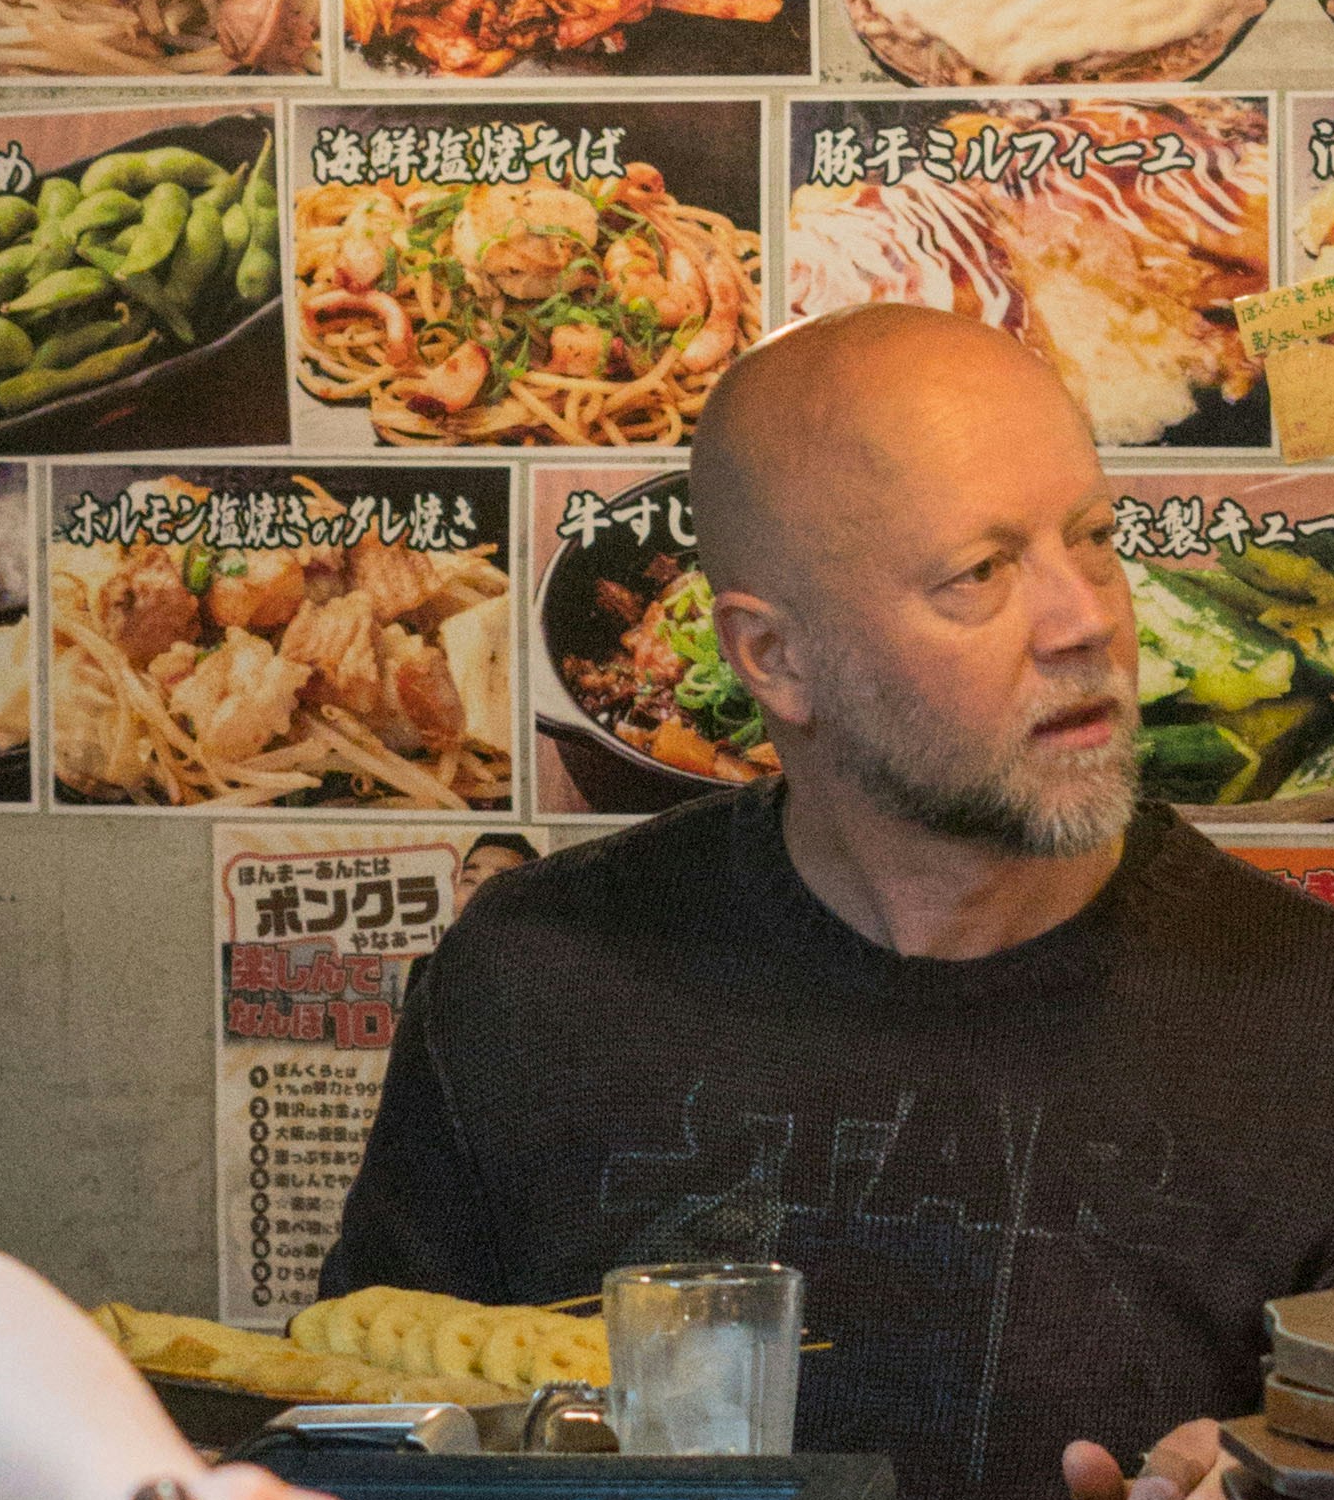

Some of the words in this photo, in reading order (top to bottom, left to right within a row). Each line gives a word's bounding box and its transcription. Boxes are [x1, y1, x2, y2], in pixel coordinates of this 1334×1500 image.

[312, 125, 627, 186] 海鮮塩焼そば
[810, 125, 1195, 187] 豚平ミルフィーユ
[69, 490, 478, 551] ホルモン塩焼きorタレ焼き
[255, 876, 440, 938] ボンクラ
[231, 944, 382, 995] 楽しんで
[275, 1081, 385, 1097] 1%の努力と99
